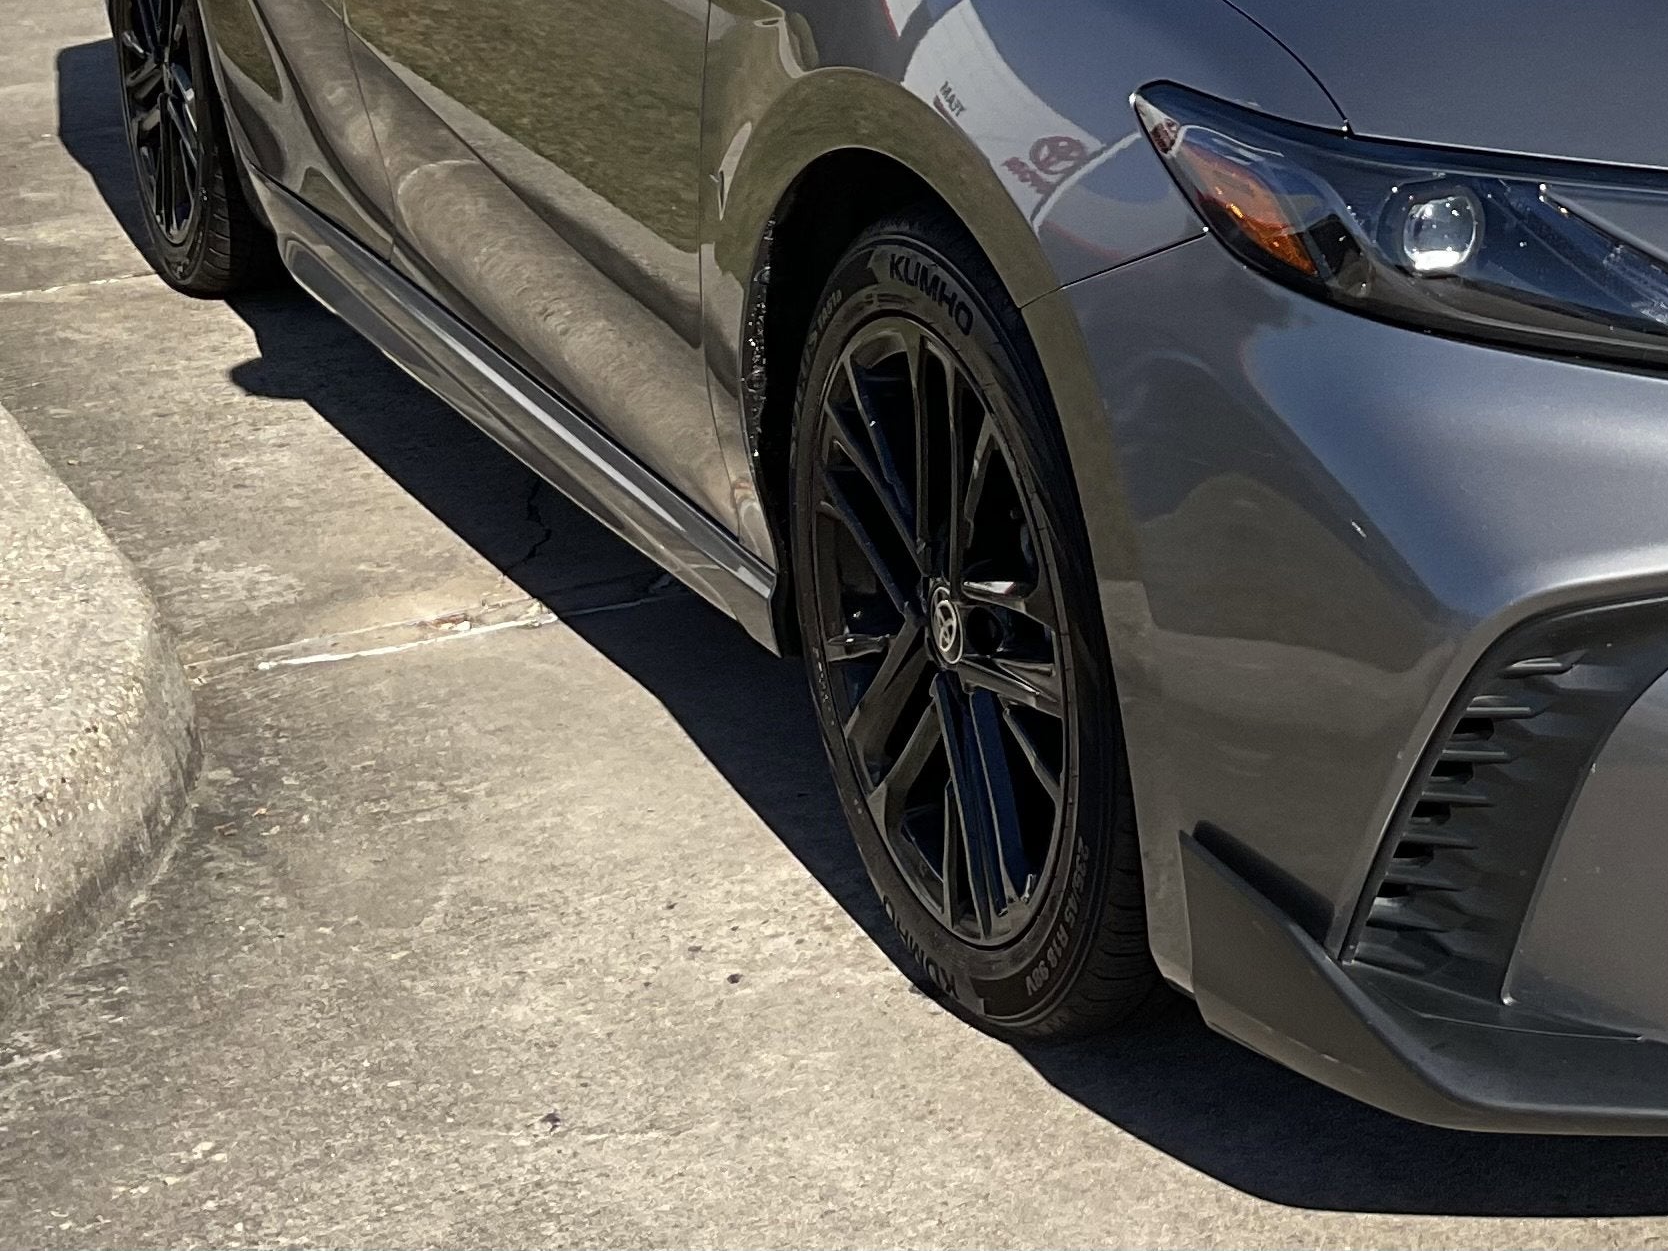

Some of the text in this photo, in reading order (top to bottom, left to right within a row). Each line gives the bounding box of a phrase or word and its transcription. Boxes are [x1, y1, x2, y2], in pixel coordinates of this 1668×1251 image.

[889, 253, 974, 336] KUMHO
[1025, 835, 1090, 997] 235/45 R18 98V
